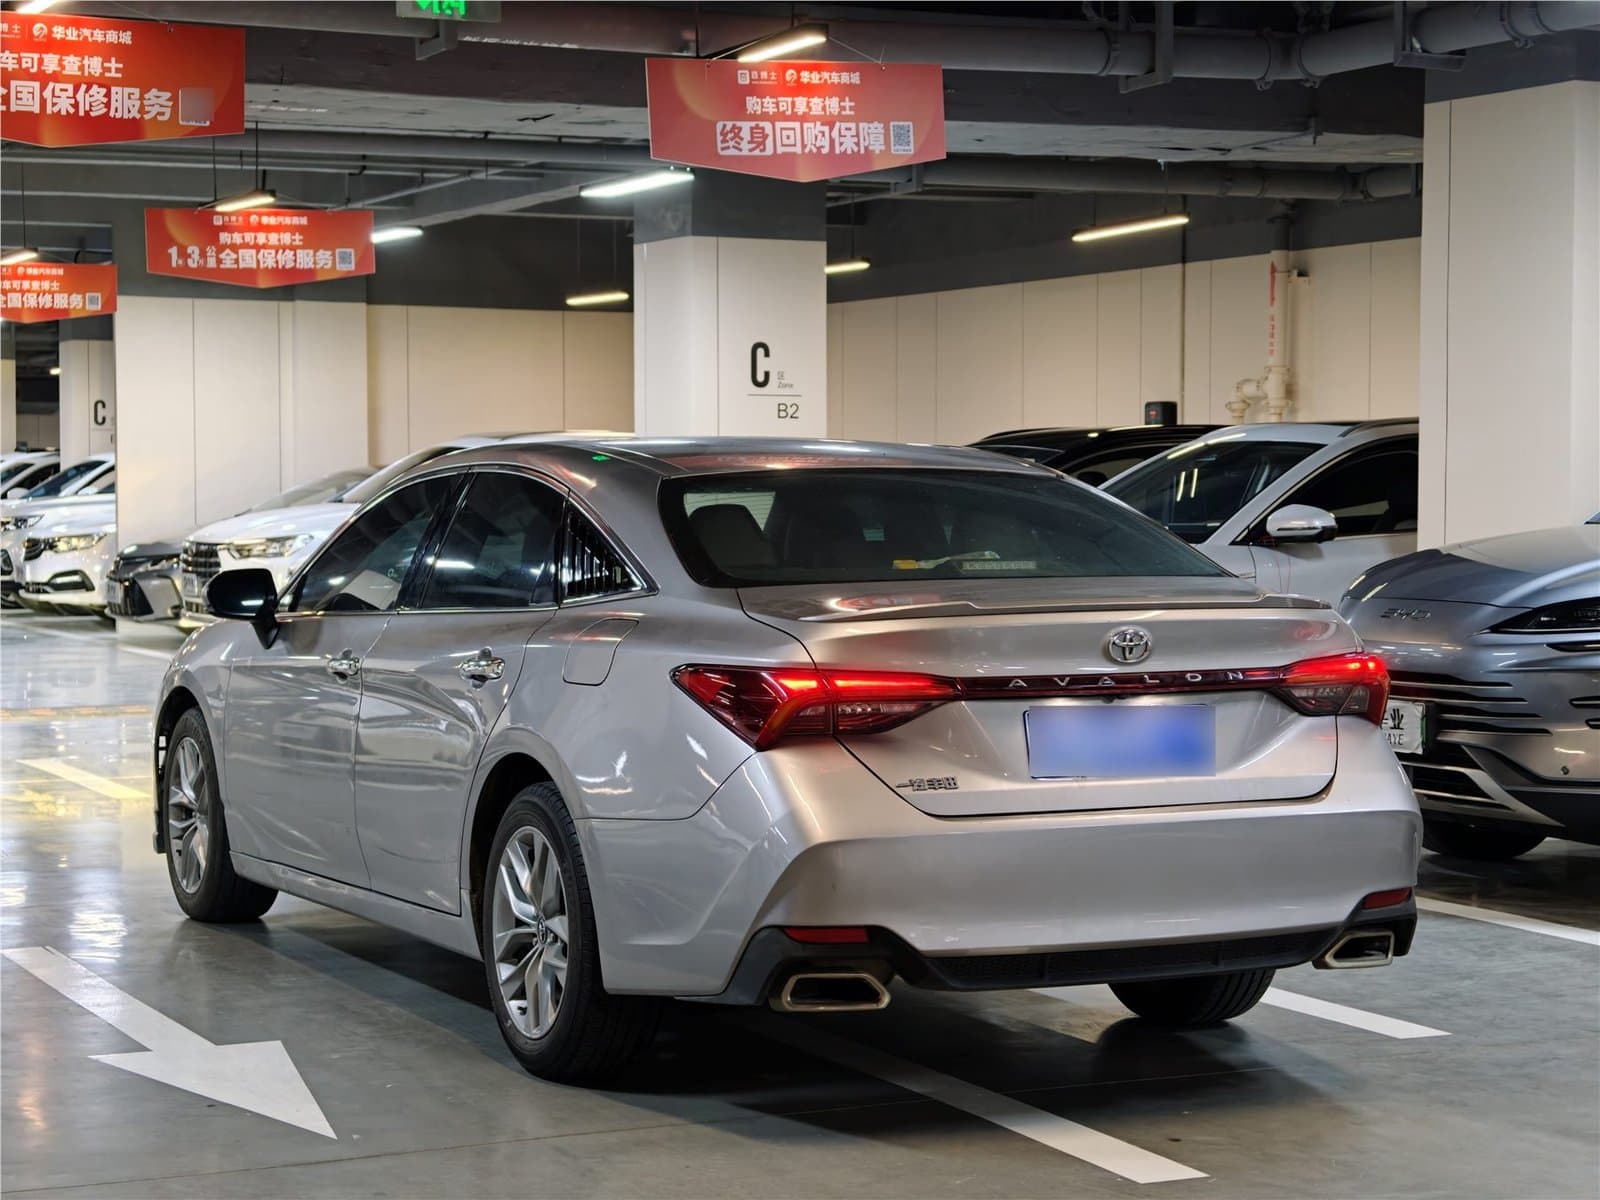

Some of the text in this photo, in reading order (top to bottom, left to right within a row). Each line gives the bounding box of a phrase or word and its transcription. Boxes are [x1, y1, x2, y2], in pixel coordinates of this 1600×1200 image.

[52, 25, 133, 45] 华业汽车商城
[800, 70, 861, 84] 华业汽车商城
[0, 80, 173, 121] 国保修服务
[746, 96, 855, 115] 购车可享查博士
[718, 120, 886, 155] 终身回购保障
[219, 232, 304, 245] 购车可享查博士
[751, 341, 770, 388] C
[94, 400, 106, 426] C
[777, 403, 799, 419] B2
[1008, 671, 1244, 688] AVALON
[896, 776, 959, 792] 一汽丰田
